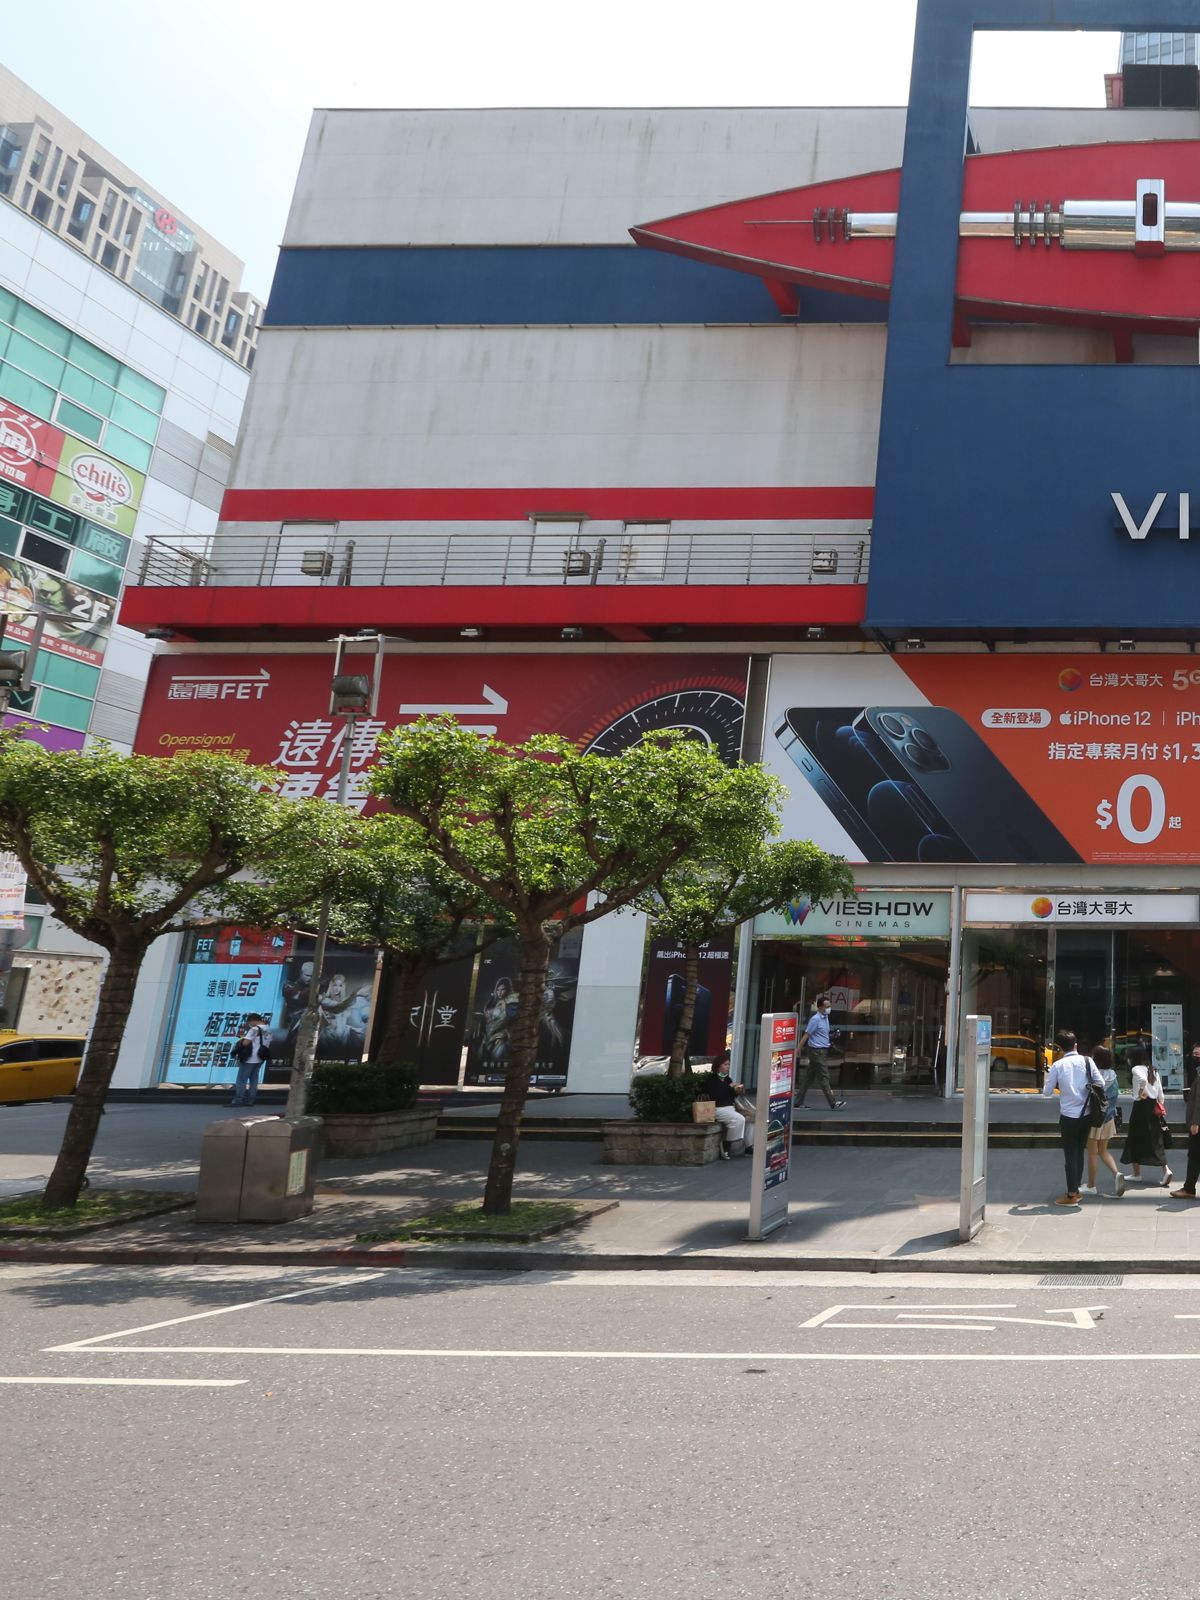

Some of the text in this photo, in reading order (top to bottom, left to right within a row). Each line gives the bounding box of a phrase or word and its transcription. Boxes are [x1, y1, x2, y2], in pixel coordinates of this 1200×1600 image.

[77, 463, 126, 498] chili's
[70, 595, 110, 622] 2F
[1089, 673, 1164, 687] 台灣大哥大
[991, 711, 1042, 725] 全新登場
[1073, 710, 1130, 726] iPhone
[1133, 711, 1151, 725] 12
[159, 733, 236, 748] Opensignal
[1048, 742, 1159, 760] 指定專案月付
[1168, 816, 1182, 829] 起
[819, 901, 934, 916] VIESHOW
[1057, 901, 1133, 916] 台灣大哥大
[835, 920, 911, 928] CINEMAS
[196, 939, 214, 950] FET
